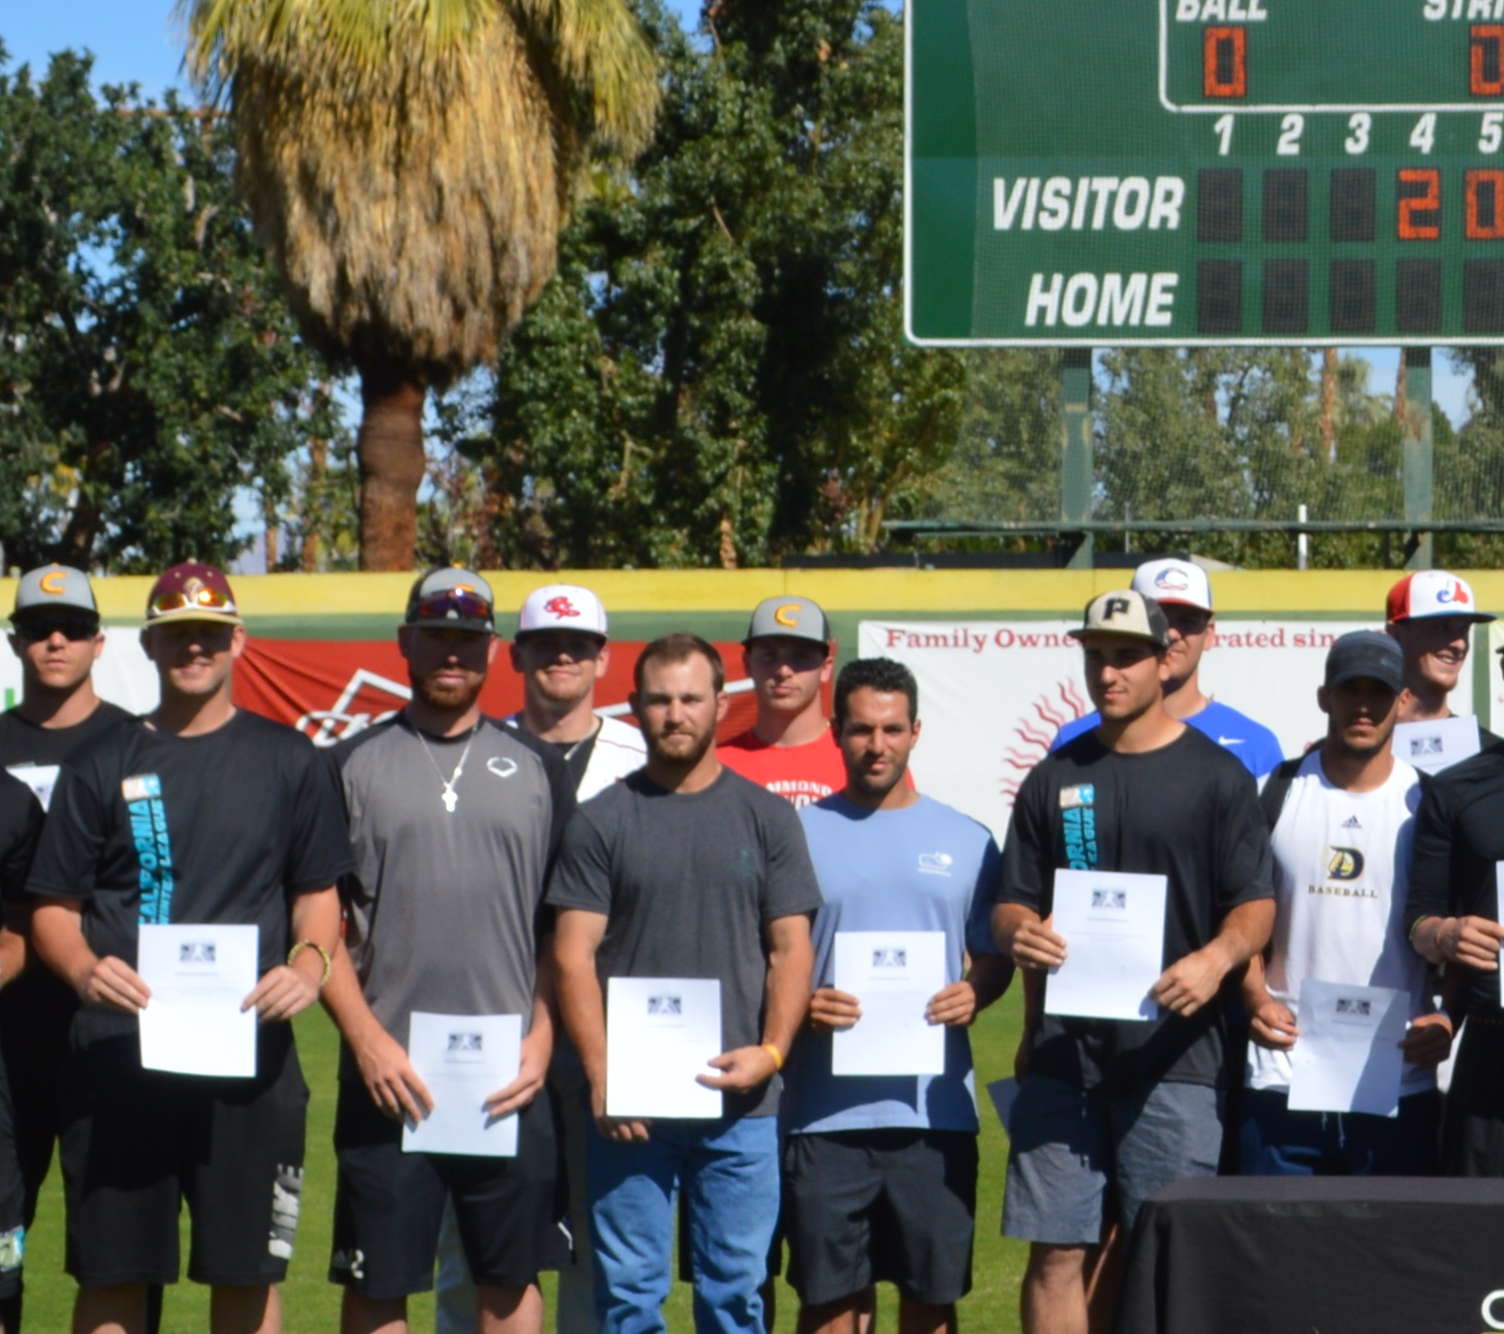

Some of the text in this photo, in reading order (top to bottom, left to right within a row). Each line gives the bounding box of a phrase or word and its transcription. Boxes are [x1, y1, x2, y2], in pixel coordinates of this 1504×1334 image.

[1212, 113, 1235, 155] 1
[1276, 113, 1304, 155] 2
[1344, 113, 1372, 155] 3
[1408, 113, 1437, 155] 4
[992, 175, 1186, 232] VISITOR
[1024, 272, 1179, 328] HOME
[885, 628, 988, 654] Family
[993, 628, 1085, 650] Owne
[1307, 883, 1379, 899] BASEBALL
